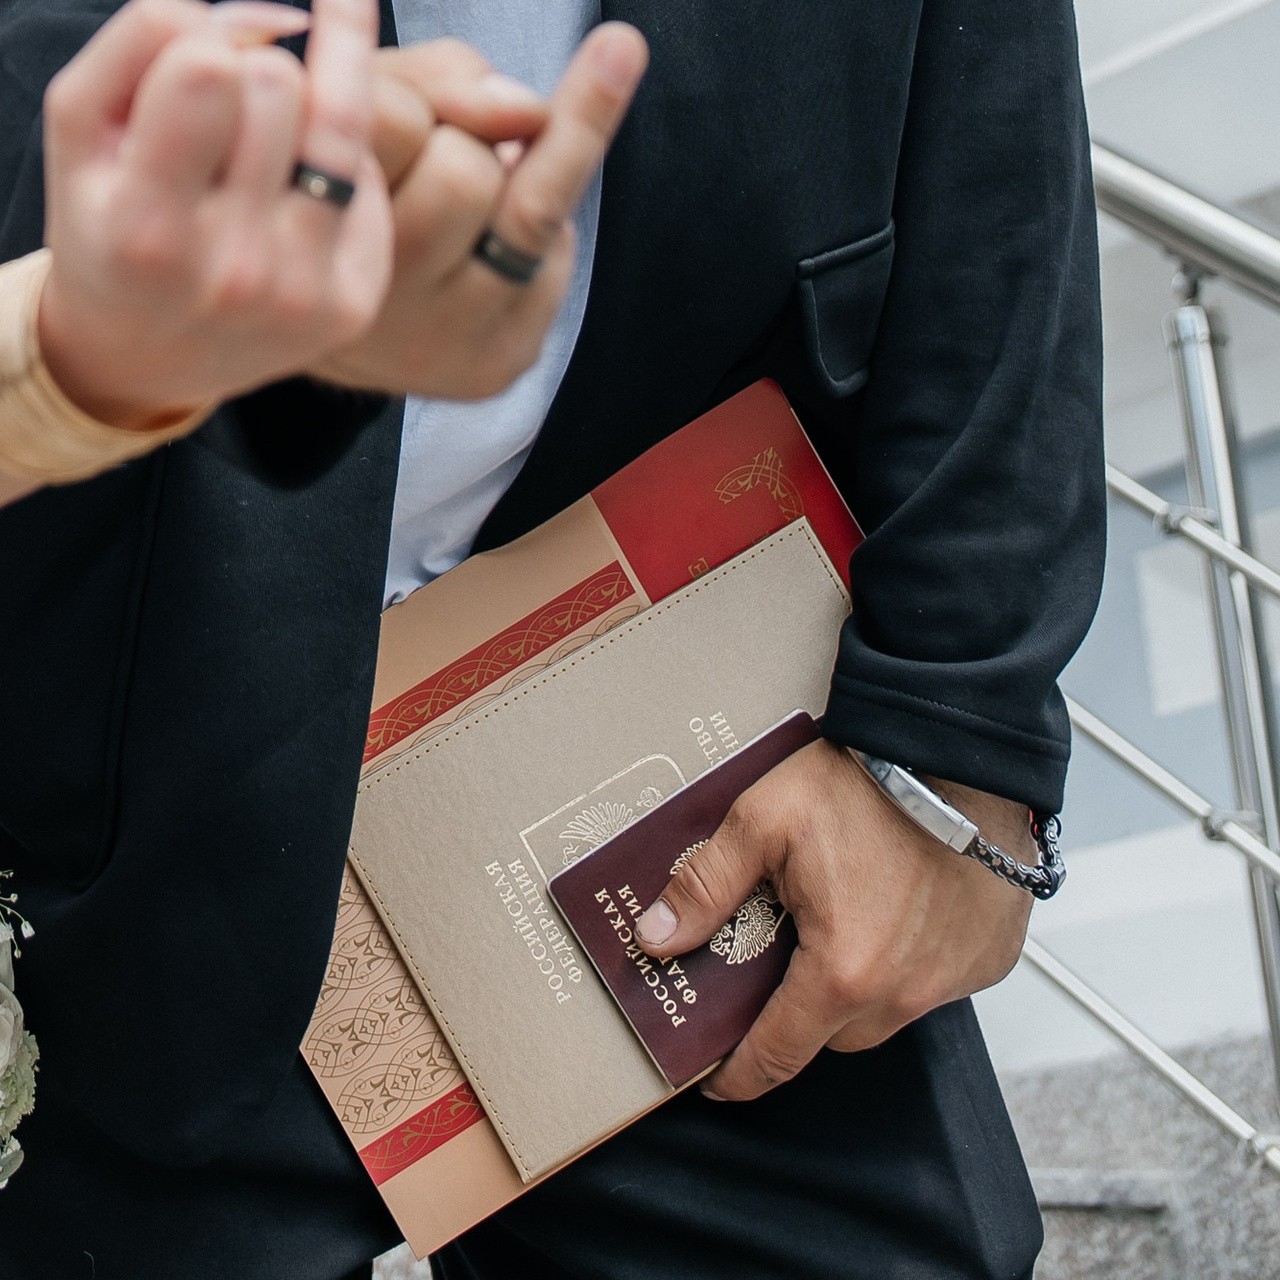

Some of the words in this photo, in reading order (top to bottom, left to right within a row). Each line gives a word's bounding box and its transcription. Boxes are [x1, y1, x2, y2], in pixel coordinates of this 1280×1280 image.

[485, 860, 572, 1005] РОССИЙСКАЯ
[507, 857, 582, 983] ФЕДЕРАЦИЯ
[594, 888, 687, 1028] РОССИЙСКАЯ
